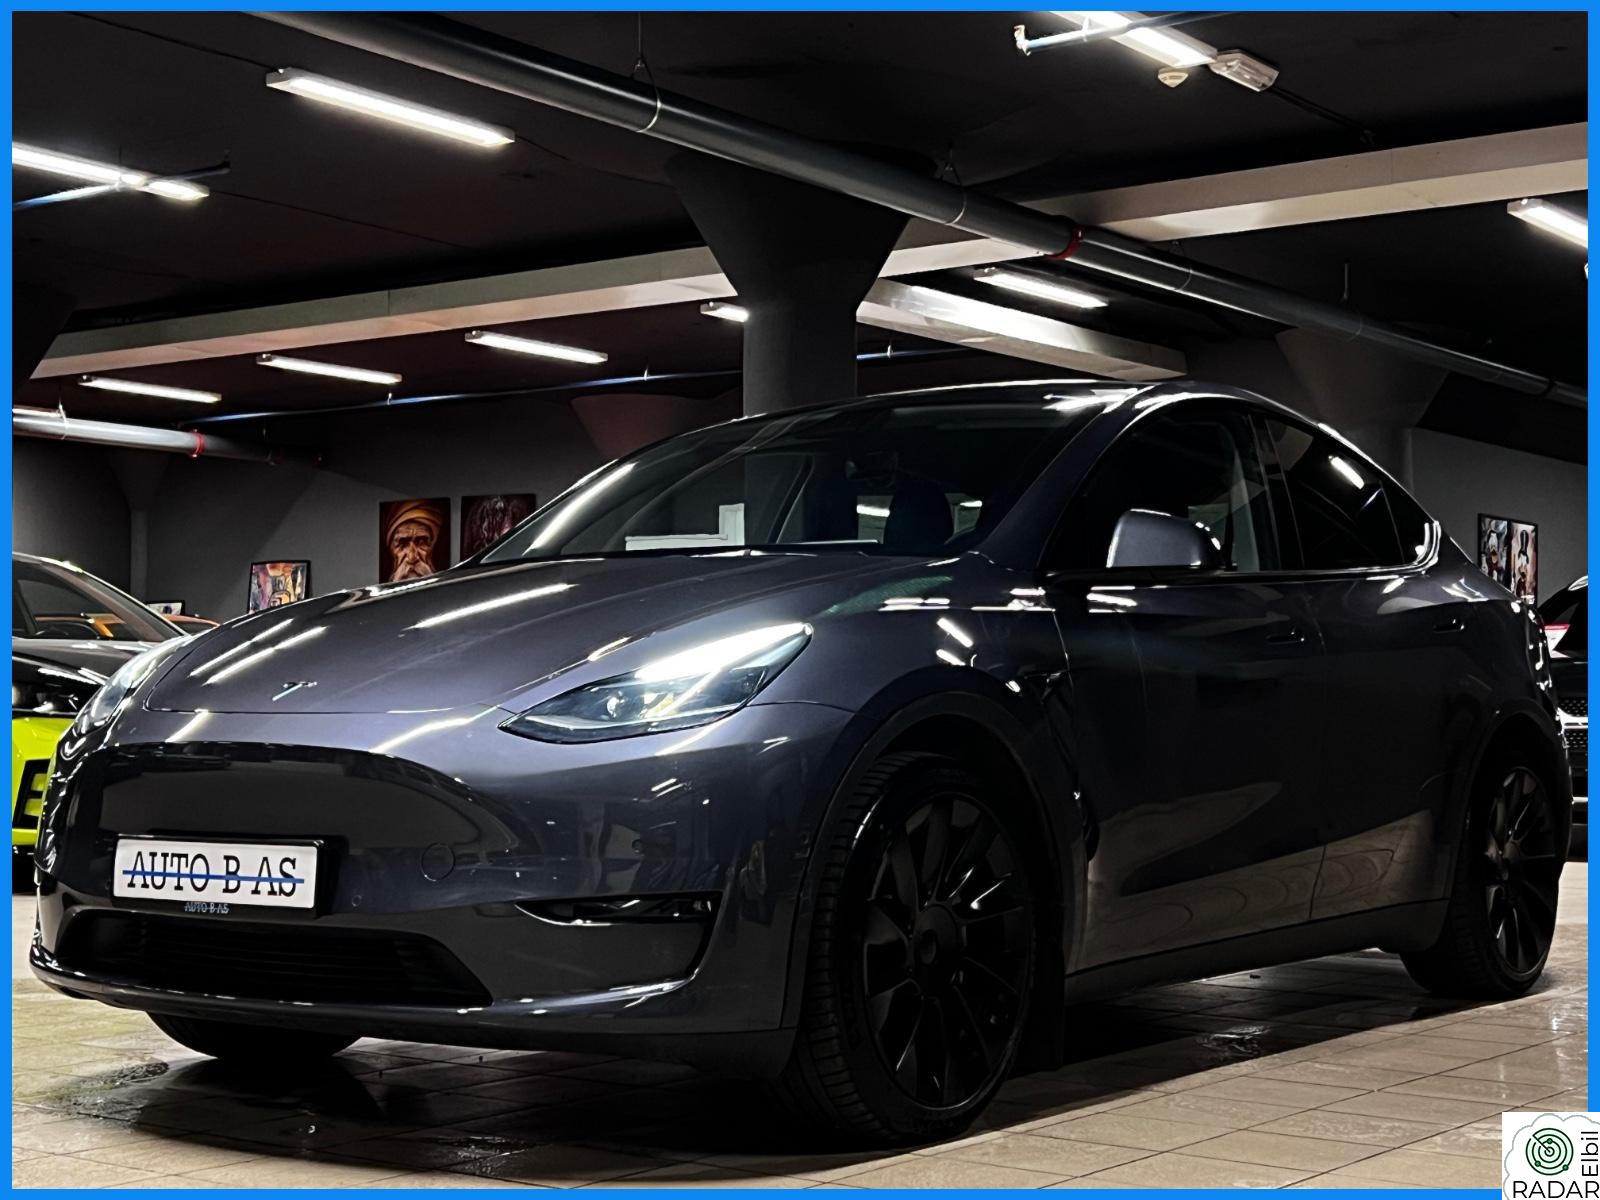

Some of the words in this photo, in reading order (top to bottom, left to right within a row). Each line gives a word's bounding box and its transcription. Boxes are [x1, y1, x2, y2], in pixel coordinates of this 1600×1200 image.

[127, 851, 210, 892] AUTO
[222, 855, 241, 893] B
[251, 856, 297, 897] AS
[184, 901, 208, 912] AUTO
